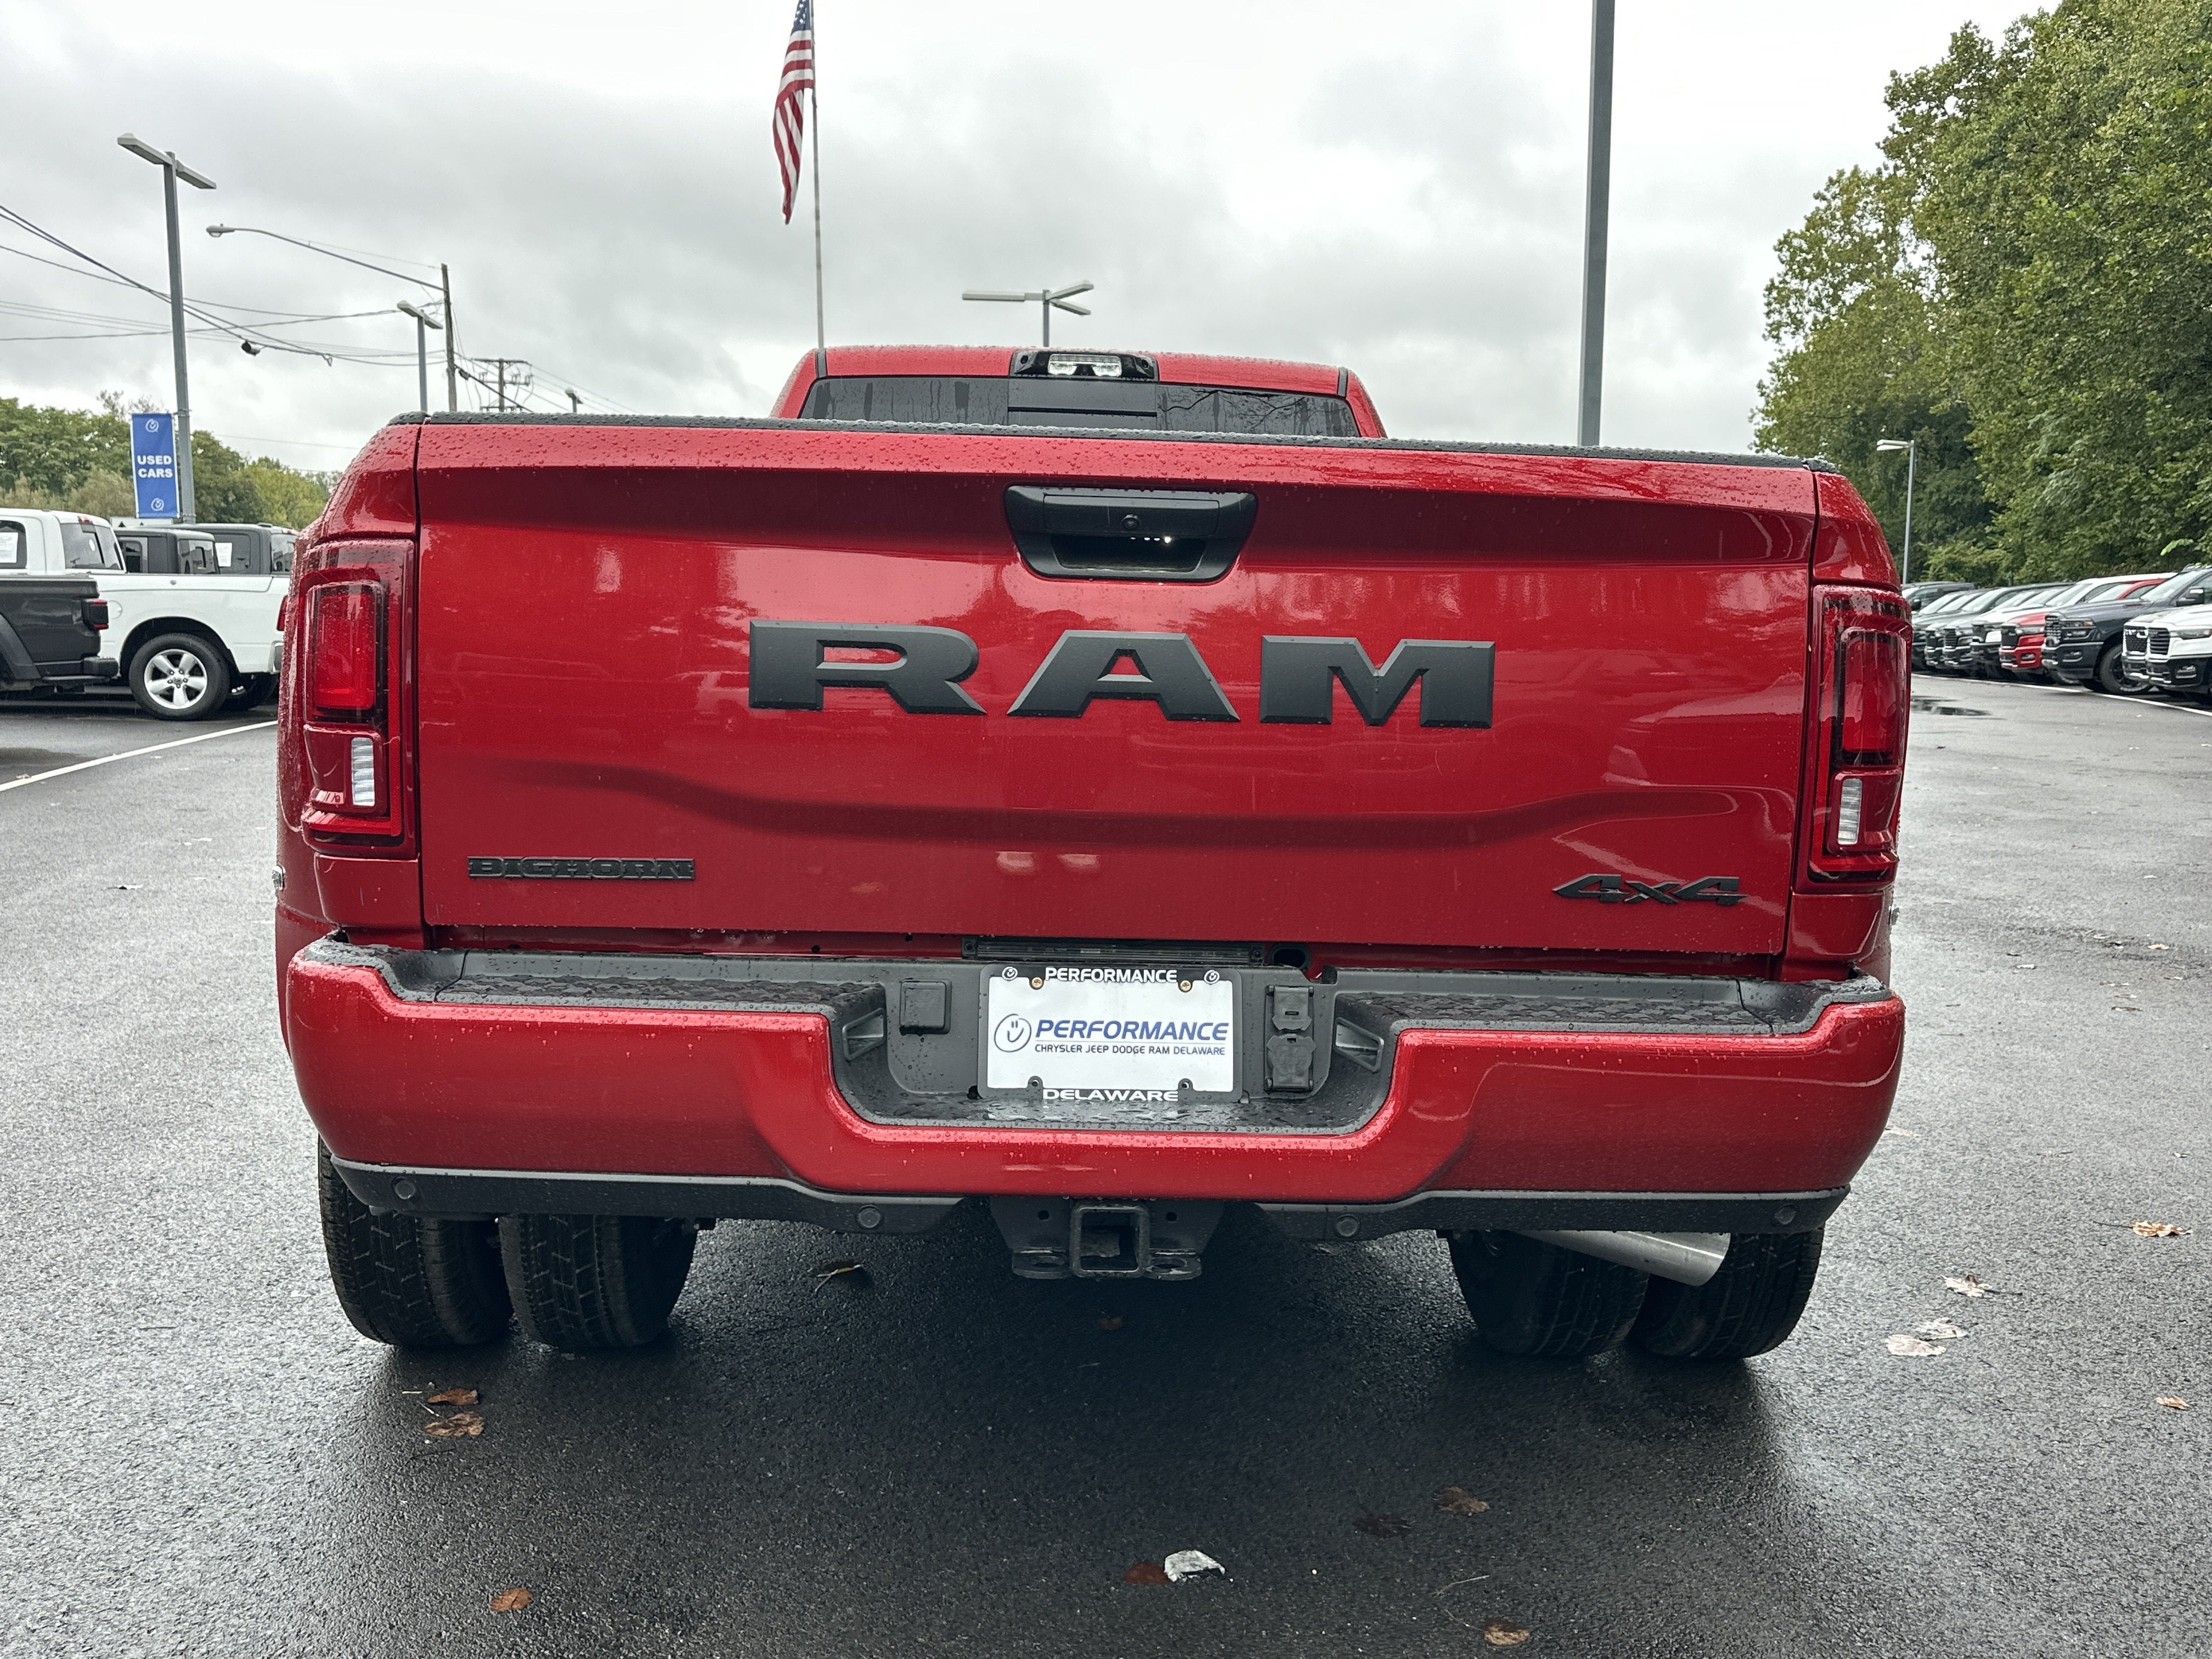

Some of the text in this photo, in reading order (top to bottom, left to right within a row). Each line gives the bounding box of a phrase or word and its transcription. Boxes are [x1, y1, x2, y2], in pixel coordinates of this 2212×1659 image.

[137, 455, 172, 465] USED
[138, 469, 173, 478] CARS
[749, 619, 1496, 729] RAM
[467, 856, 695, 881] BIGHORN
[1045, 967, 1177, 983] PERFORMANCE
[1035, 1020, 1229, 1040] PERFORMANCE
[1035, 1044, 1225, 1056] CHRYSLER JEEP DODGE RAM DELAWARE
[1043, 1089, 1178, 1102] DELAWARE
